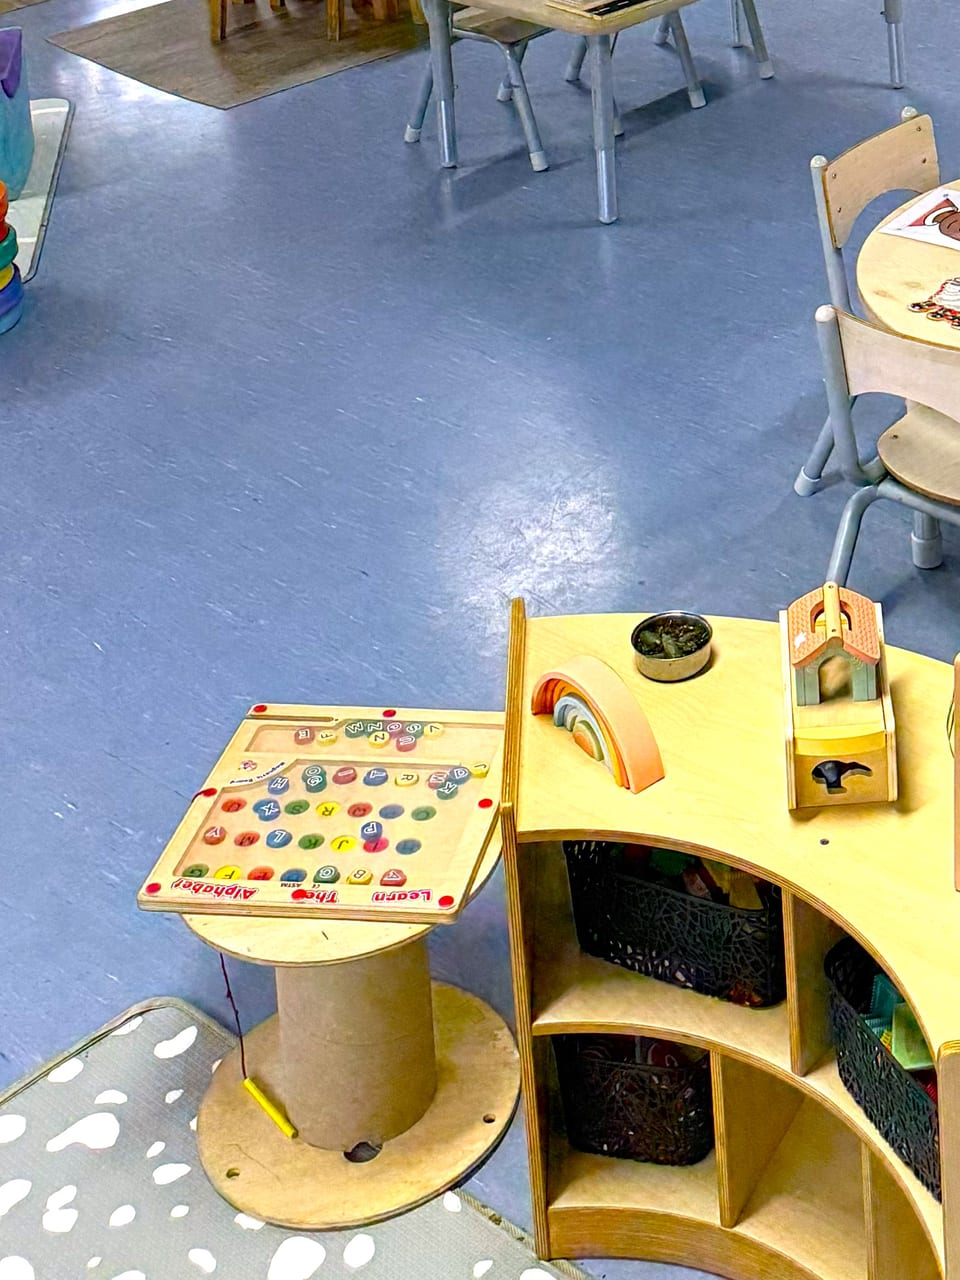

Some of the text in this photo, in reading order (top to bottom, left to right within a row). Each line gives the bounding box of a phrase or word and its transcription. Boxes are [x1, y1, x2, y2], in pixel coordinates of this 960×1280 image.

[171, 877, 432, 904] Learn The Alphabet
